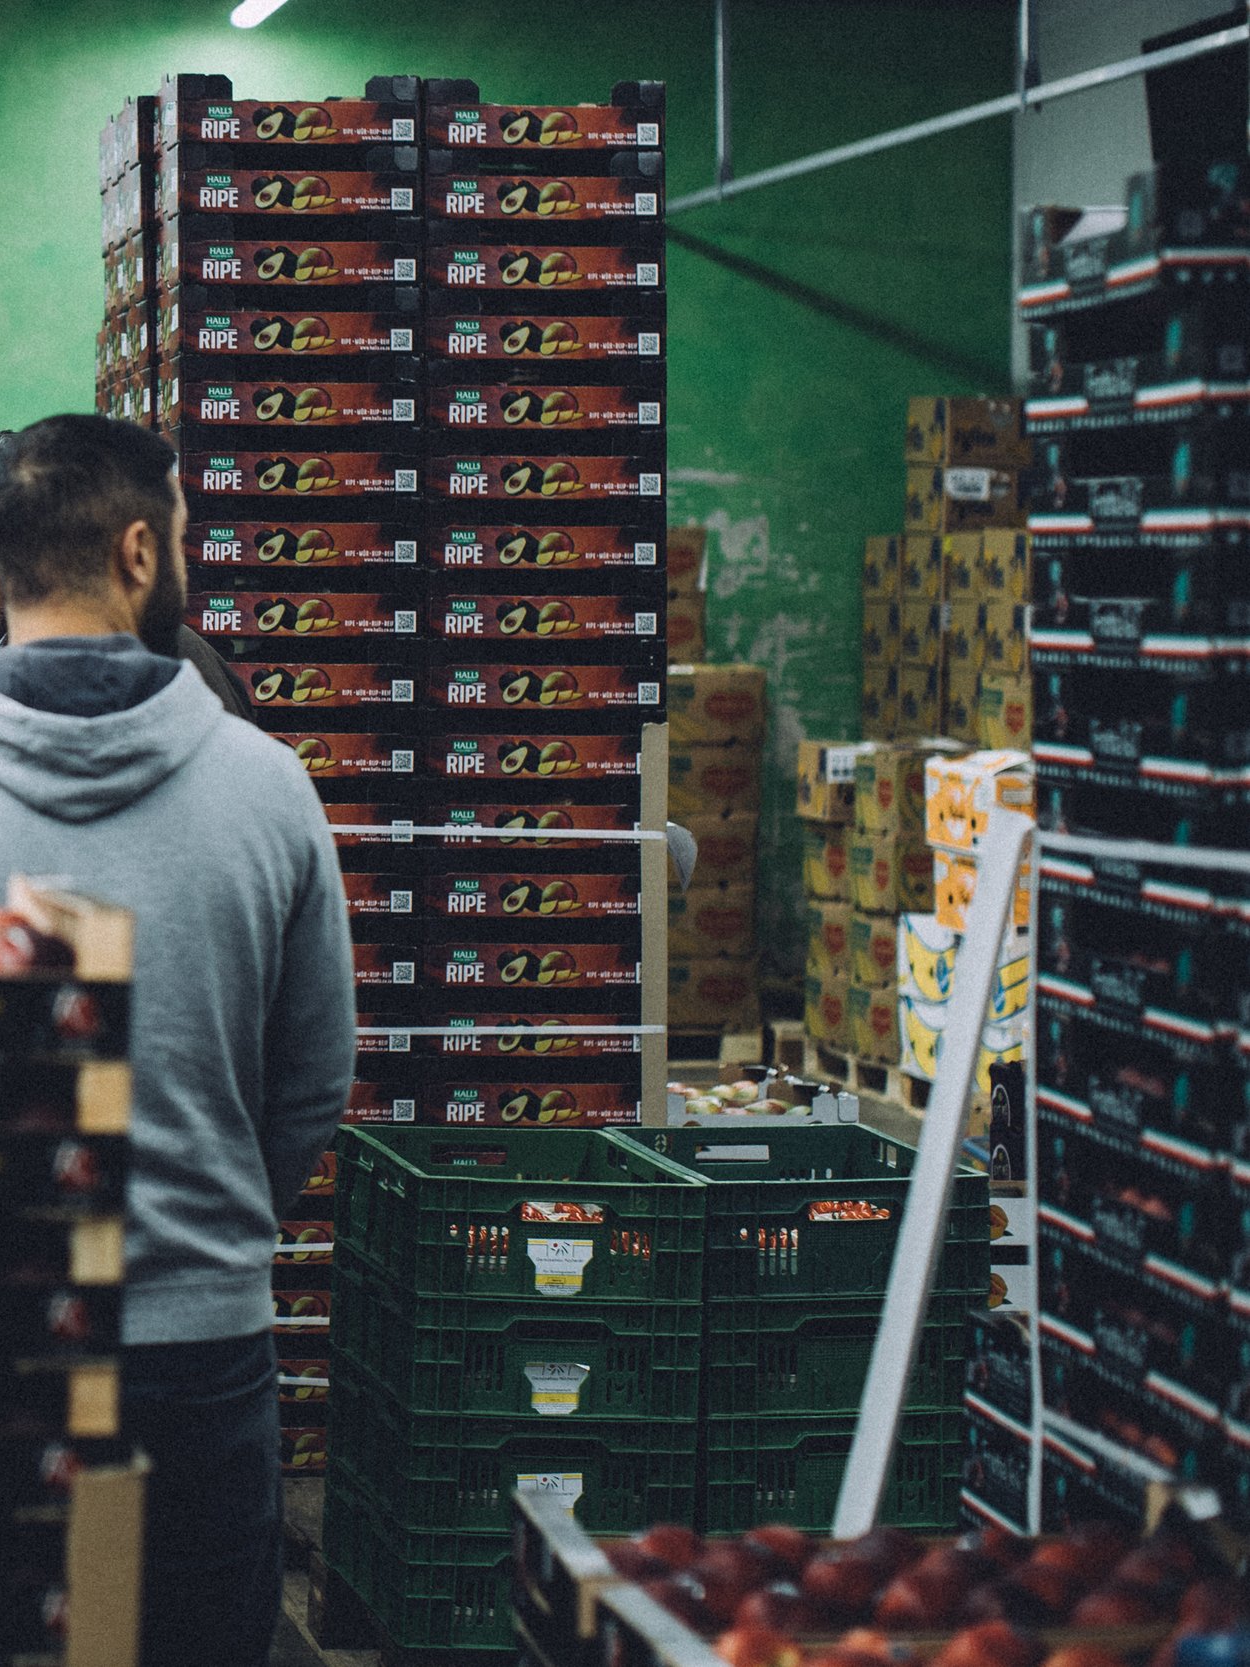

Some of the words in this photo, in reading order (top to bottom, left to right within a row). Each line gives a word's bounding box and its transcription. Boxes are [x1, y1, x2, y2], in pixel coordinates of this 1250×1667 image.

[201, 120, 240, 139] RIPE
[448, 126, 487, 144] RIPE
[200, 190, 239, 208] RIPE
[446, 196, 485, 214] RIPE
[202, 260, 241, 279] RIPE
[447, 266, 486, 284] RIPE
[199, 330, 238, 349] RIPE
[448, 336, 487, 354] RIPE
[201, 402, 240, 420] RIPE
[448, 404, 487, 423] RIPE
[203, 472, 242, 490] RIPE
[449, 476, 488, 494] RIPE
[203, 542, 242, 561] RIPE
[444, 546, 483, 564] RIPE
[202, 612, 241, 631] RIPE
[445, 616, 484, 634] RIPE
[447, 684, 486, 703] RIPE
[446, 756, 485, 774] RIPE
[447, 894, 486, 913] RIPE
[446, 964, 485, 983] RIPE
[443, 1034, 482, 1051] RIPE
[446, 1104, 485, 1122] RIPE
